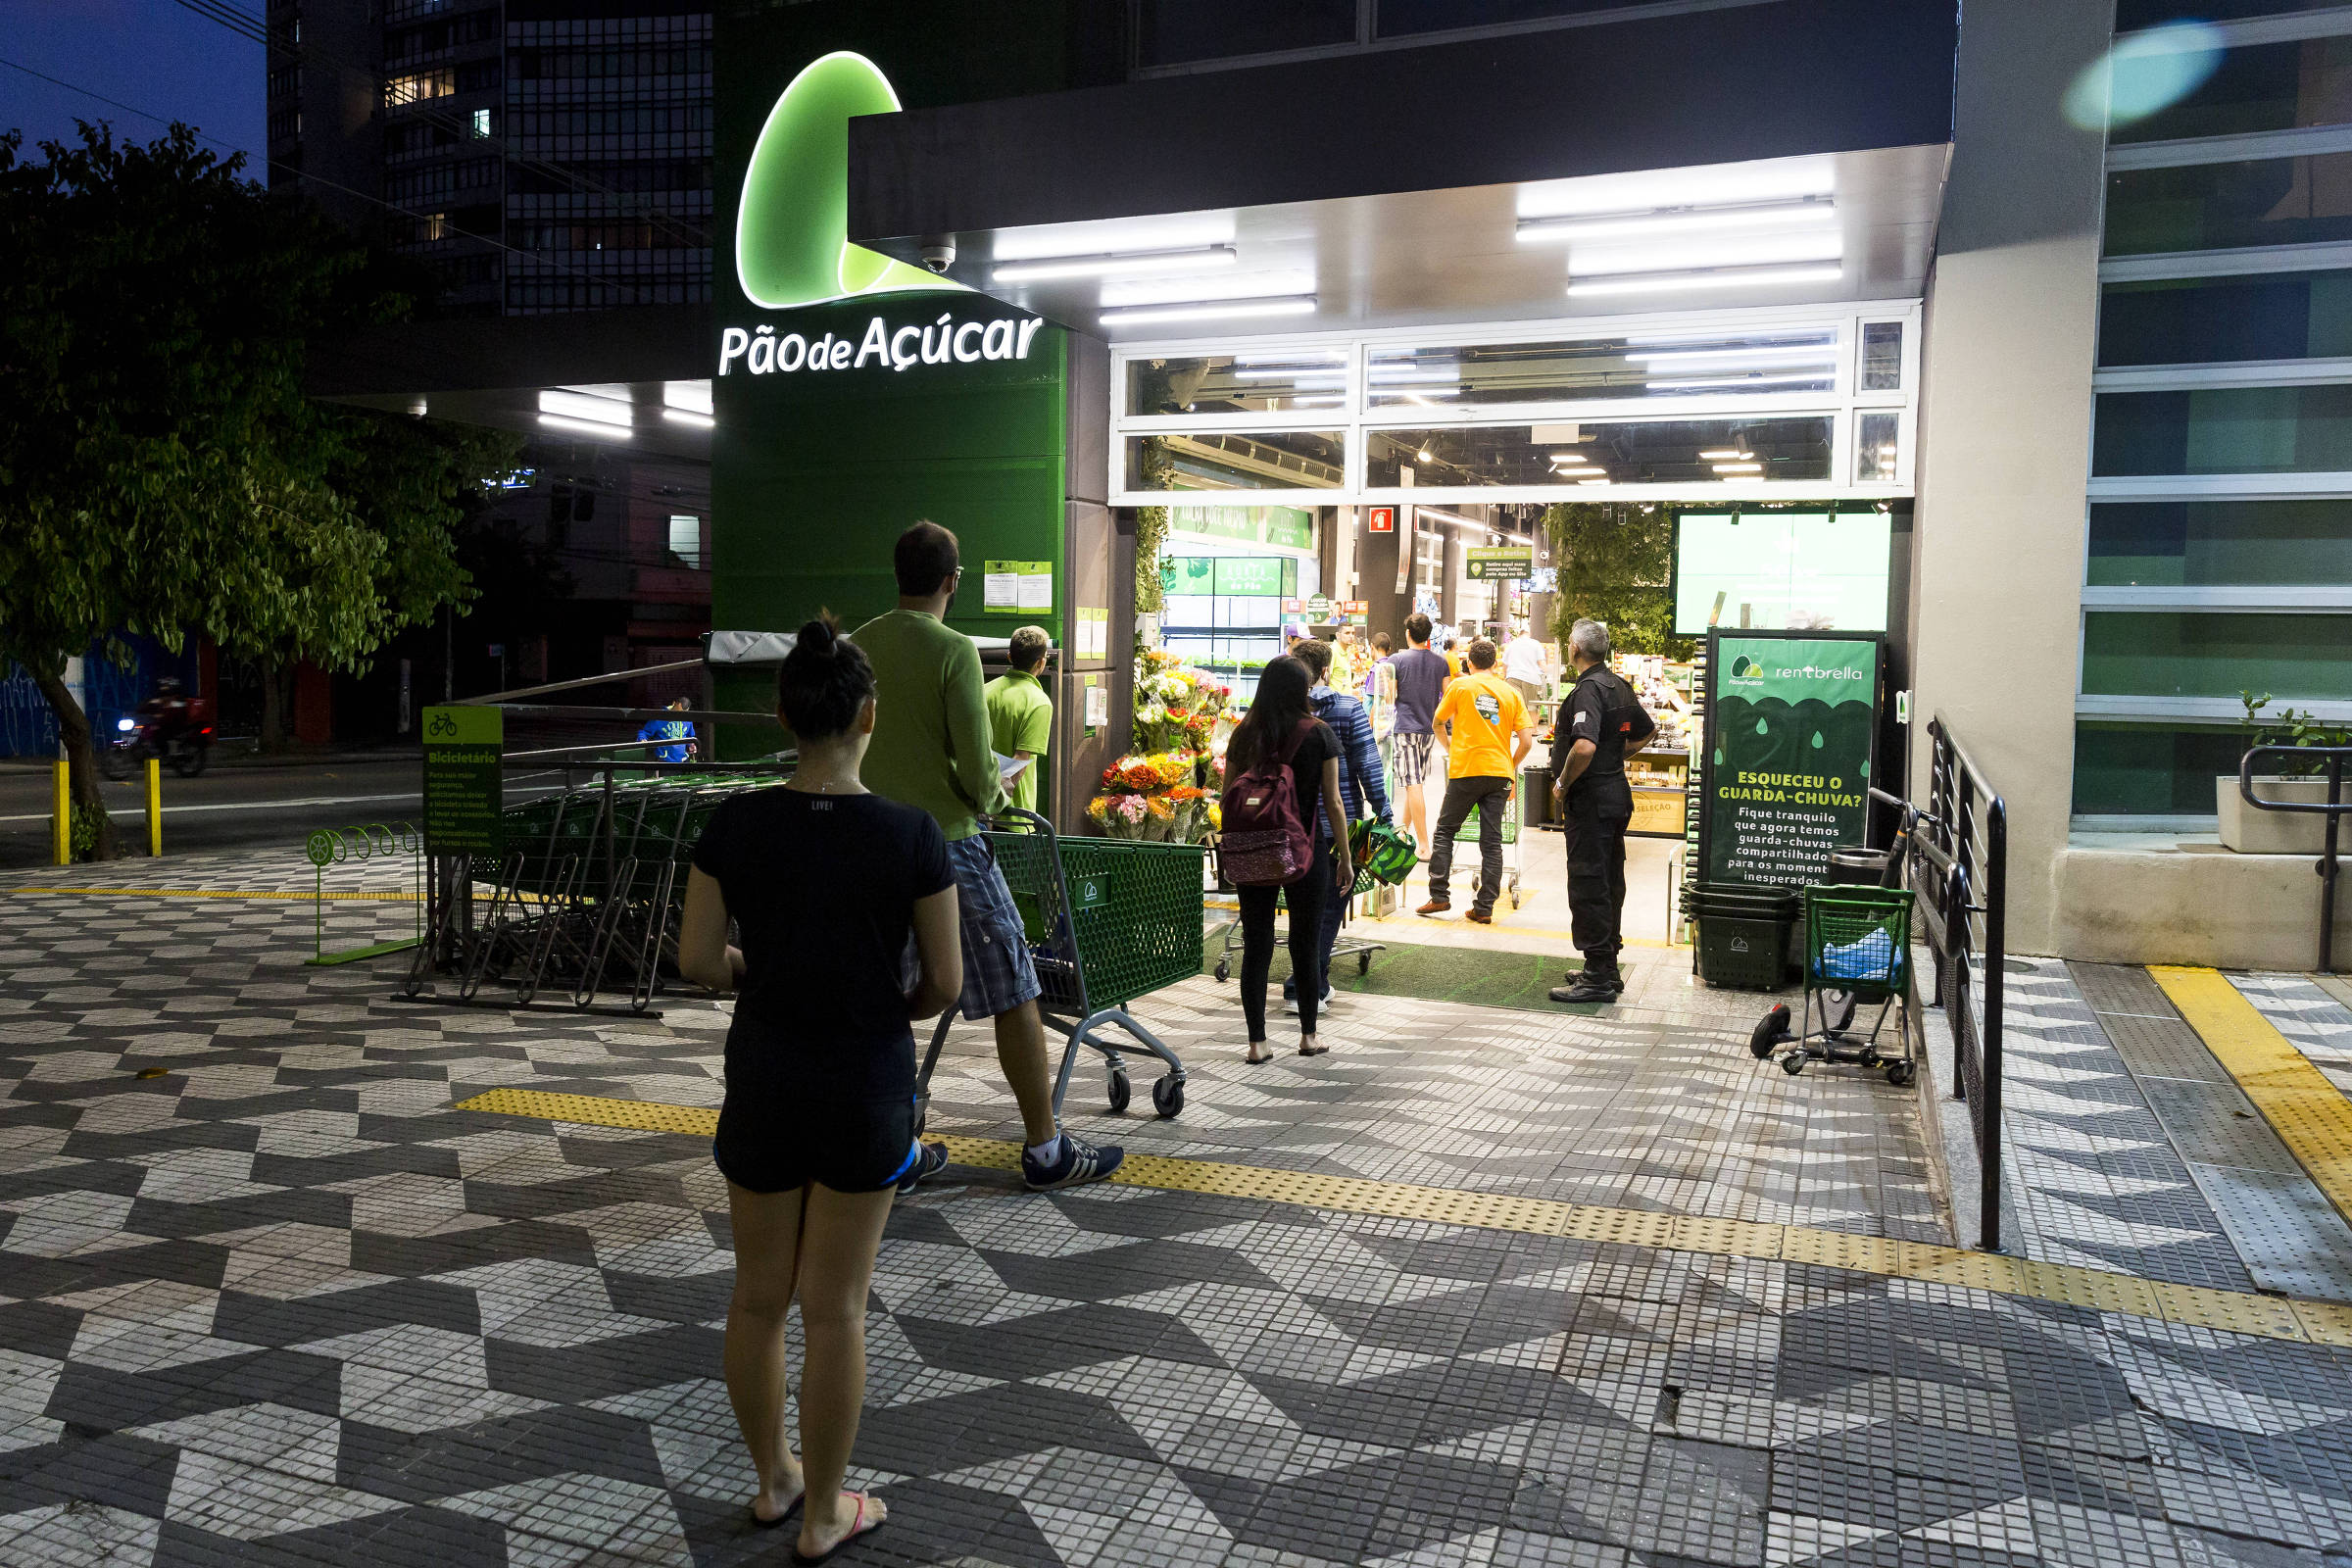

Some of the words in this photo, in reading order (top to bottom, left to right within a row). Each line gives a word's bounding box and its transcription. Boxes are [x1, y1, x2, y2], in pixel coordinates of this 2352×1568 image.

[718, 324, 808, 376] Pão
[808, 332, 852, 371] de
[854, 312, 1043, 371] Açúcar
[1776, 664, 1862, 680] rentbrella
[429, 752, 496, 763] Bicicletário
[1738, 771, 1824, 789] ESQUECEU
[1829, 777, 1842, 790] O
[1719, 787, 1862, 808] GUARDA-CHUVA?
[1637, 804, 1671, 813] SELEÇÃO
[1739, 807, 1773, 820] Fique
[1776, 809, 1836, 823] tranquilo
[1735, 821, 1756, 831] que
[1760, 823, 1796, 834] agora
[1800, 825, 1839, 836] temos
[1739, 834, 1833, 850] guarda-chuvas
[1737, 846, 1828, 861] compartilhado
[1728, 858, 1753, 868] para
[1758, 861, 1772, 870] os
[1776, 862, 1828, 874] moment
[1743, 870, 1823, 886] inesperados.
